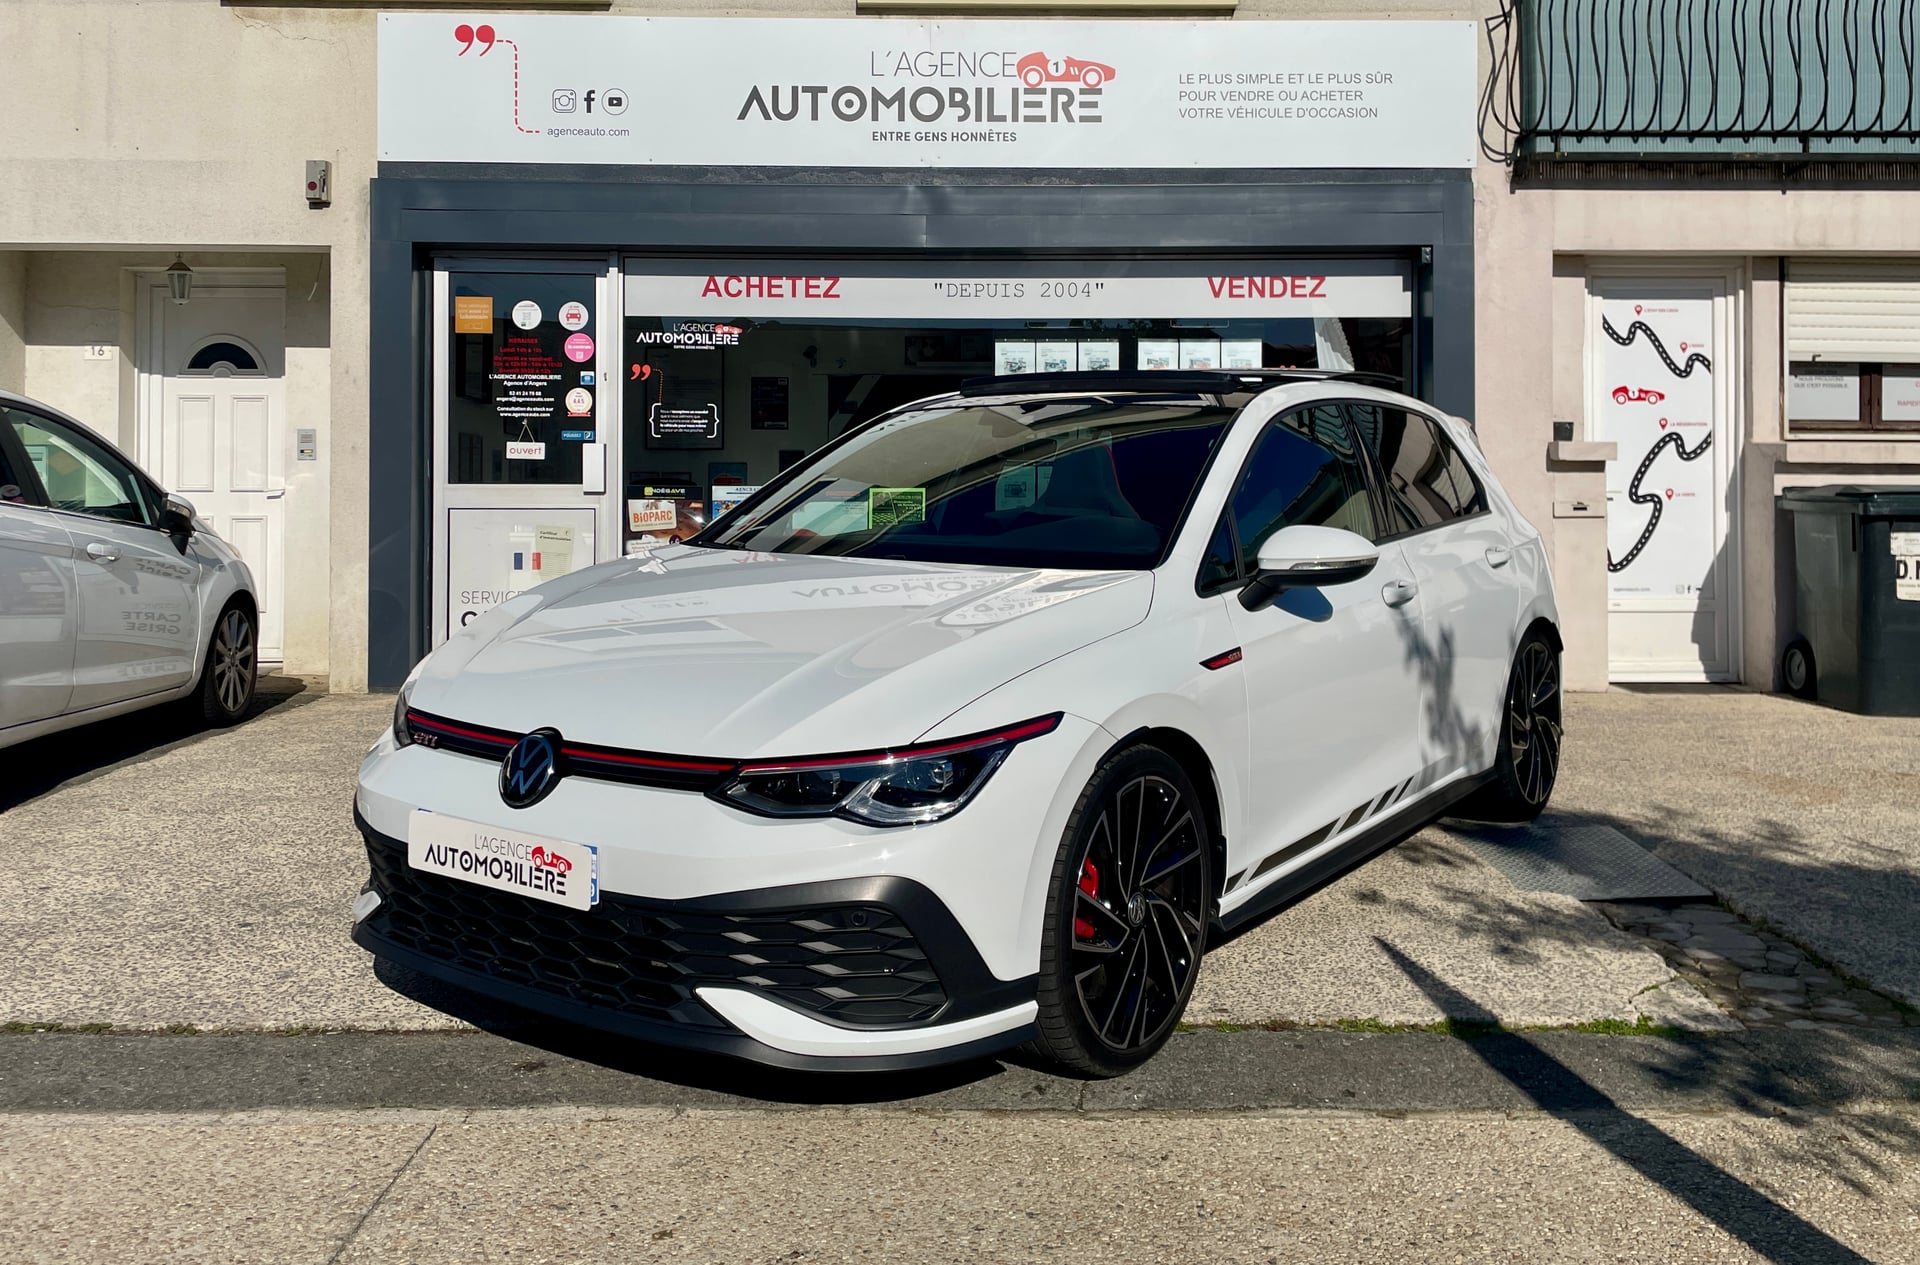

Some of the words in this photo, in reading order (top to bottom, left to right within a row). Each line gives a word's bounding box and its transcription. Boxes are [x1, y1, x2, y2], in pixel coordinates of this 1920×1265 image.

[871, 50, 1017, 78] L'AGENCE
[1179, 73, 1194, 84] LE
[1198, 73, 1232, 84] PLUS
[1236, 73, 1284, 84] SIMPLE
[1288, 73, 1304, 84] ET
[1308, 73, 1324, 84] LE
[1328, 73, 1362, 84] PLUS
[1365, 71, 1393, 84] SÛR
[1179, 90, 1216, 101] POUR
[1220, 90, 1274, 101] VENDRE
[1278, 90, 1297, 101] OU
[1301, 90, 1363, 101] ACHETER
[736, 84, 1103, 123] AUTOMOBILIERE
[1179, 107, 1223, 118] VOTRE
[1227, 105, 1293, 118] VÉHICULE
[1296, 107, 1378, 118] D'OCCASION
[547, 126, 630, 138] agenceauto.com
[872, 131, 911, 142] ENTRE
[915, 131, 947, 142] GENS
[951, 129, 1017, 142] HONNÊTES
[701, 276, 841, 298] ACHETEZ
[1207, 276, 1327, 298] VENDEZ
[673, 323, 715, 332] L'AGENCE
[636, 332, 739, 345] AUTOMOBILIERE
[91, 345, 104, 356] 16
[509, 447, 542, 455] ouvert
[475, 833, 532, 862] L'AGENCE
[425, 843, 567, 896] AUTOMOBILIERE
